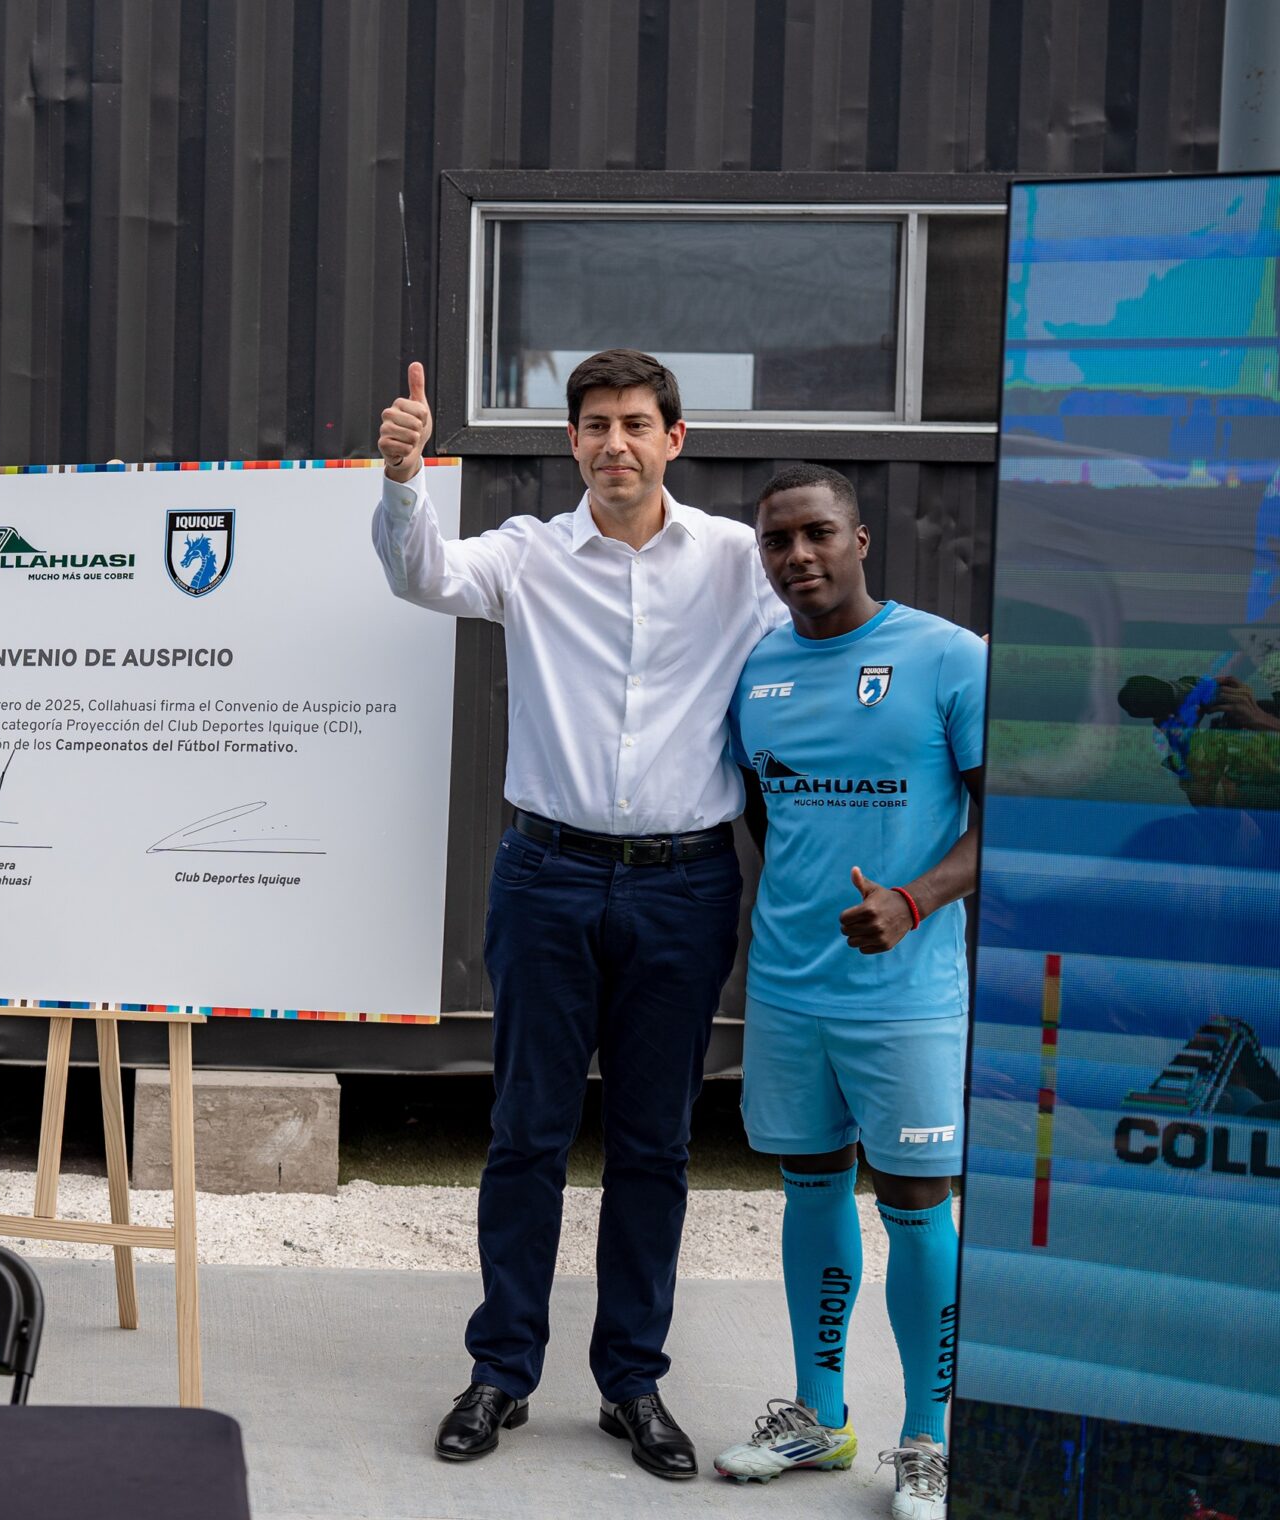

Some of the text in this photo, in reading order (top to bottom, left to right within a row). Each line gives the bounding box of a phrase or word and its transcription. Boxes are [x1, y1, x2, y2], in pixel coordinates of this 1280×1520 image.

[175, 515, 225, 530] IQUIQUE
[27, 571, 135, 581] MUCHO MÁS QUE COBRE
[84, 648, 117, 667] DE
[121, 648, 234, 668] AUSPICIO
[863, 667, 890, 675] IQUIQUE
[25, 699, 42, 711] de
[44, 698, 85, 713] 2025,
[88, 698, 157, 712] Collahuasi
[160, 699, 196, 712] firma
[198, 699, 211, 712] el
[214, 699, 279, 713] Convenio
[282, 700, 299, 713] de
[302, 700, 362, 716] Auspicio
[365, 703, 397, 716] para
[1, 718, 63, 734] categoría
[66, 718, 140, 734] Proyección
[143, 719, 164, 732] del
[167, 719, 198, 732] Club
[202, 719, 265, 735] Deportes
[268, 720, 320, 736] Iquique
[323, 720, 362, 736] (CDI),
[13, 738, 30, 751] de
[33, 738, 52, 751] los
[55, 738, 149, 754] Campeonatos
[152, 739, 174, 752] del
[177, 739, 220, 753] Fútbol
[224, 740, 298, 753] Formativo.
[760, 778, 908, 794] LLAHUASI
[794, 799, 825, 807] MUCHO
[849, 799, 869, 808] QUE
[872, 799, 908, 808] COBRE
[174, 871, 301, 887] Club Deportes Iquique
